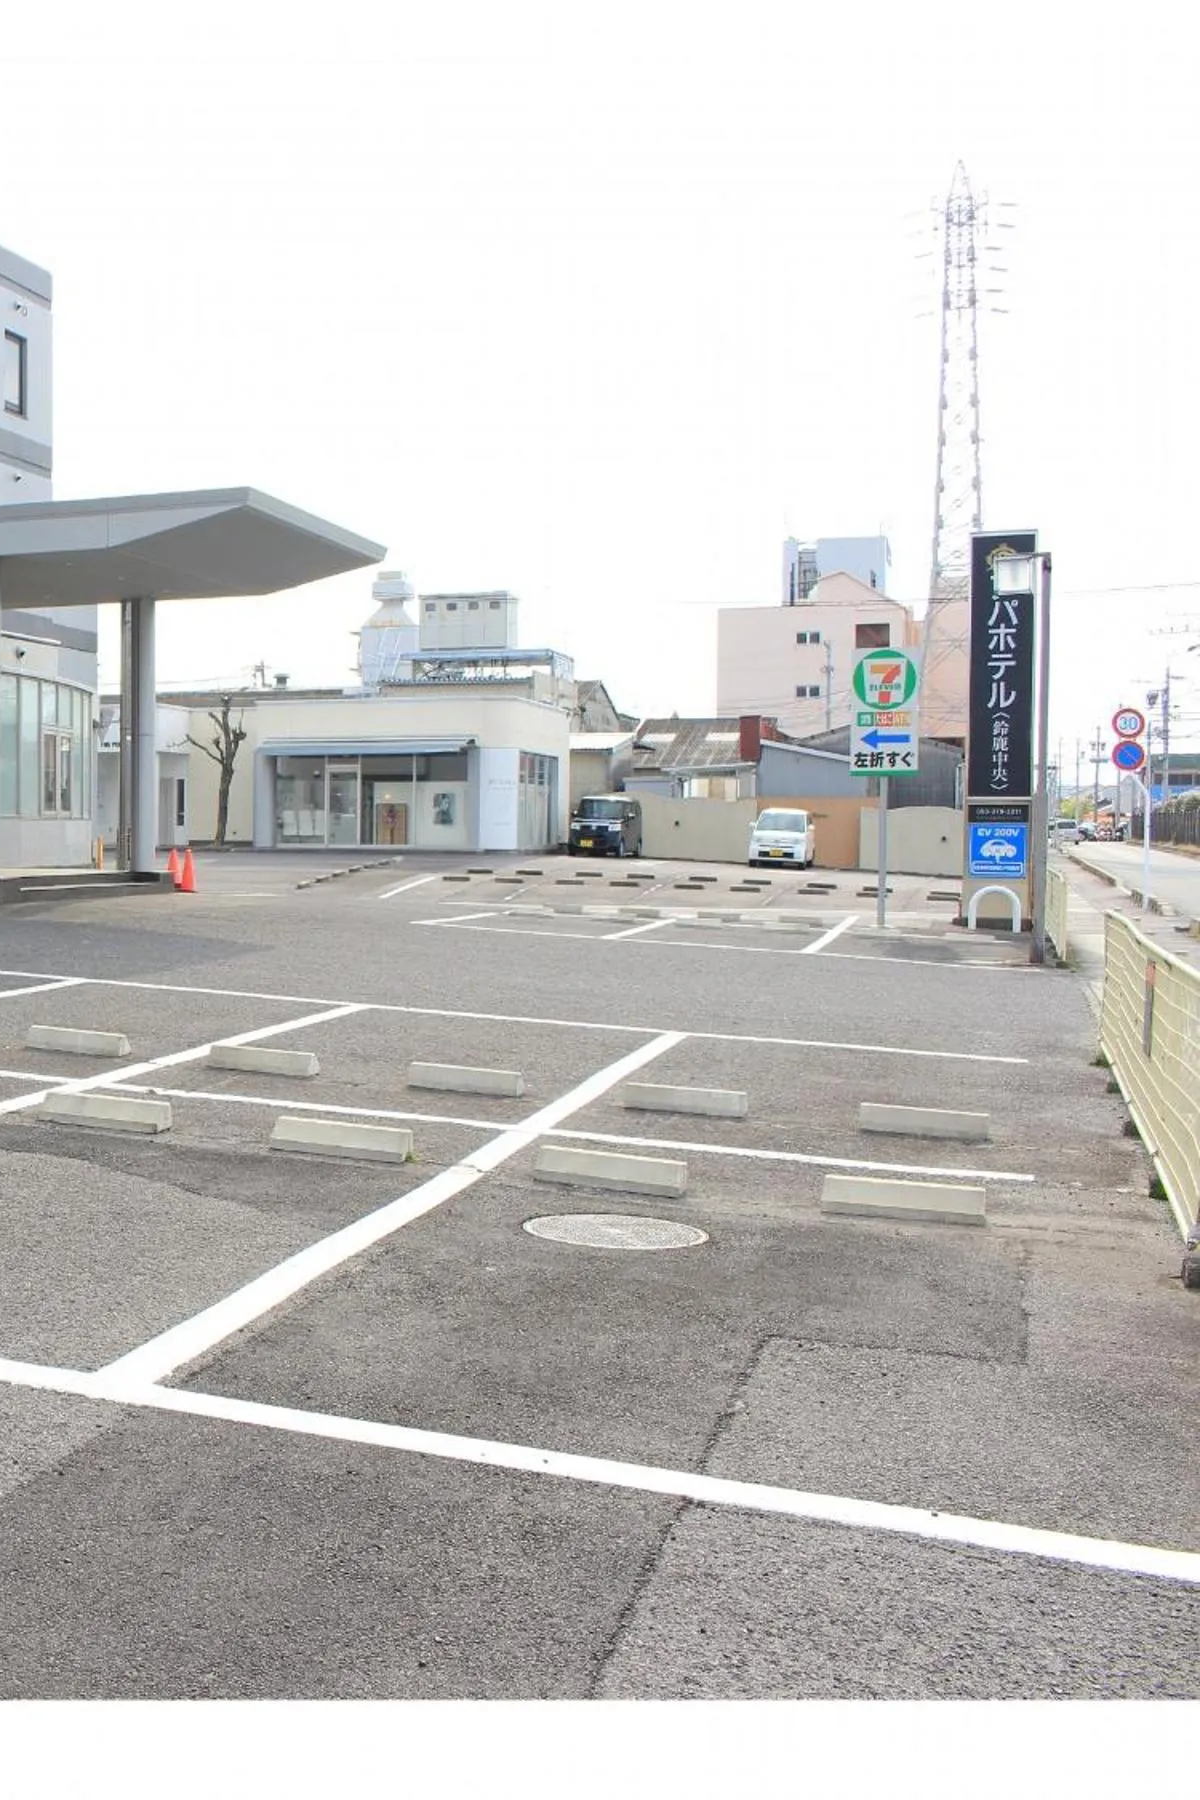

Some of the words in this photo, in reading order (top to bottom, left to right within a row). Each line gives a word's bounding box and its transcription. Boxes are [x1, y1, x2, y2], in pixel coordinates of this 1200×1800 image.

[988, 575, 1019, 709] パホテル
[854, 751, 914, 768] 左折すぐ
